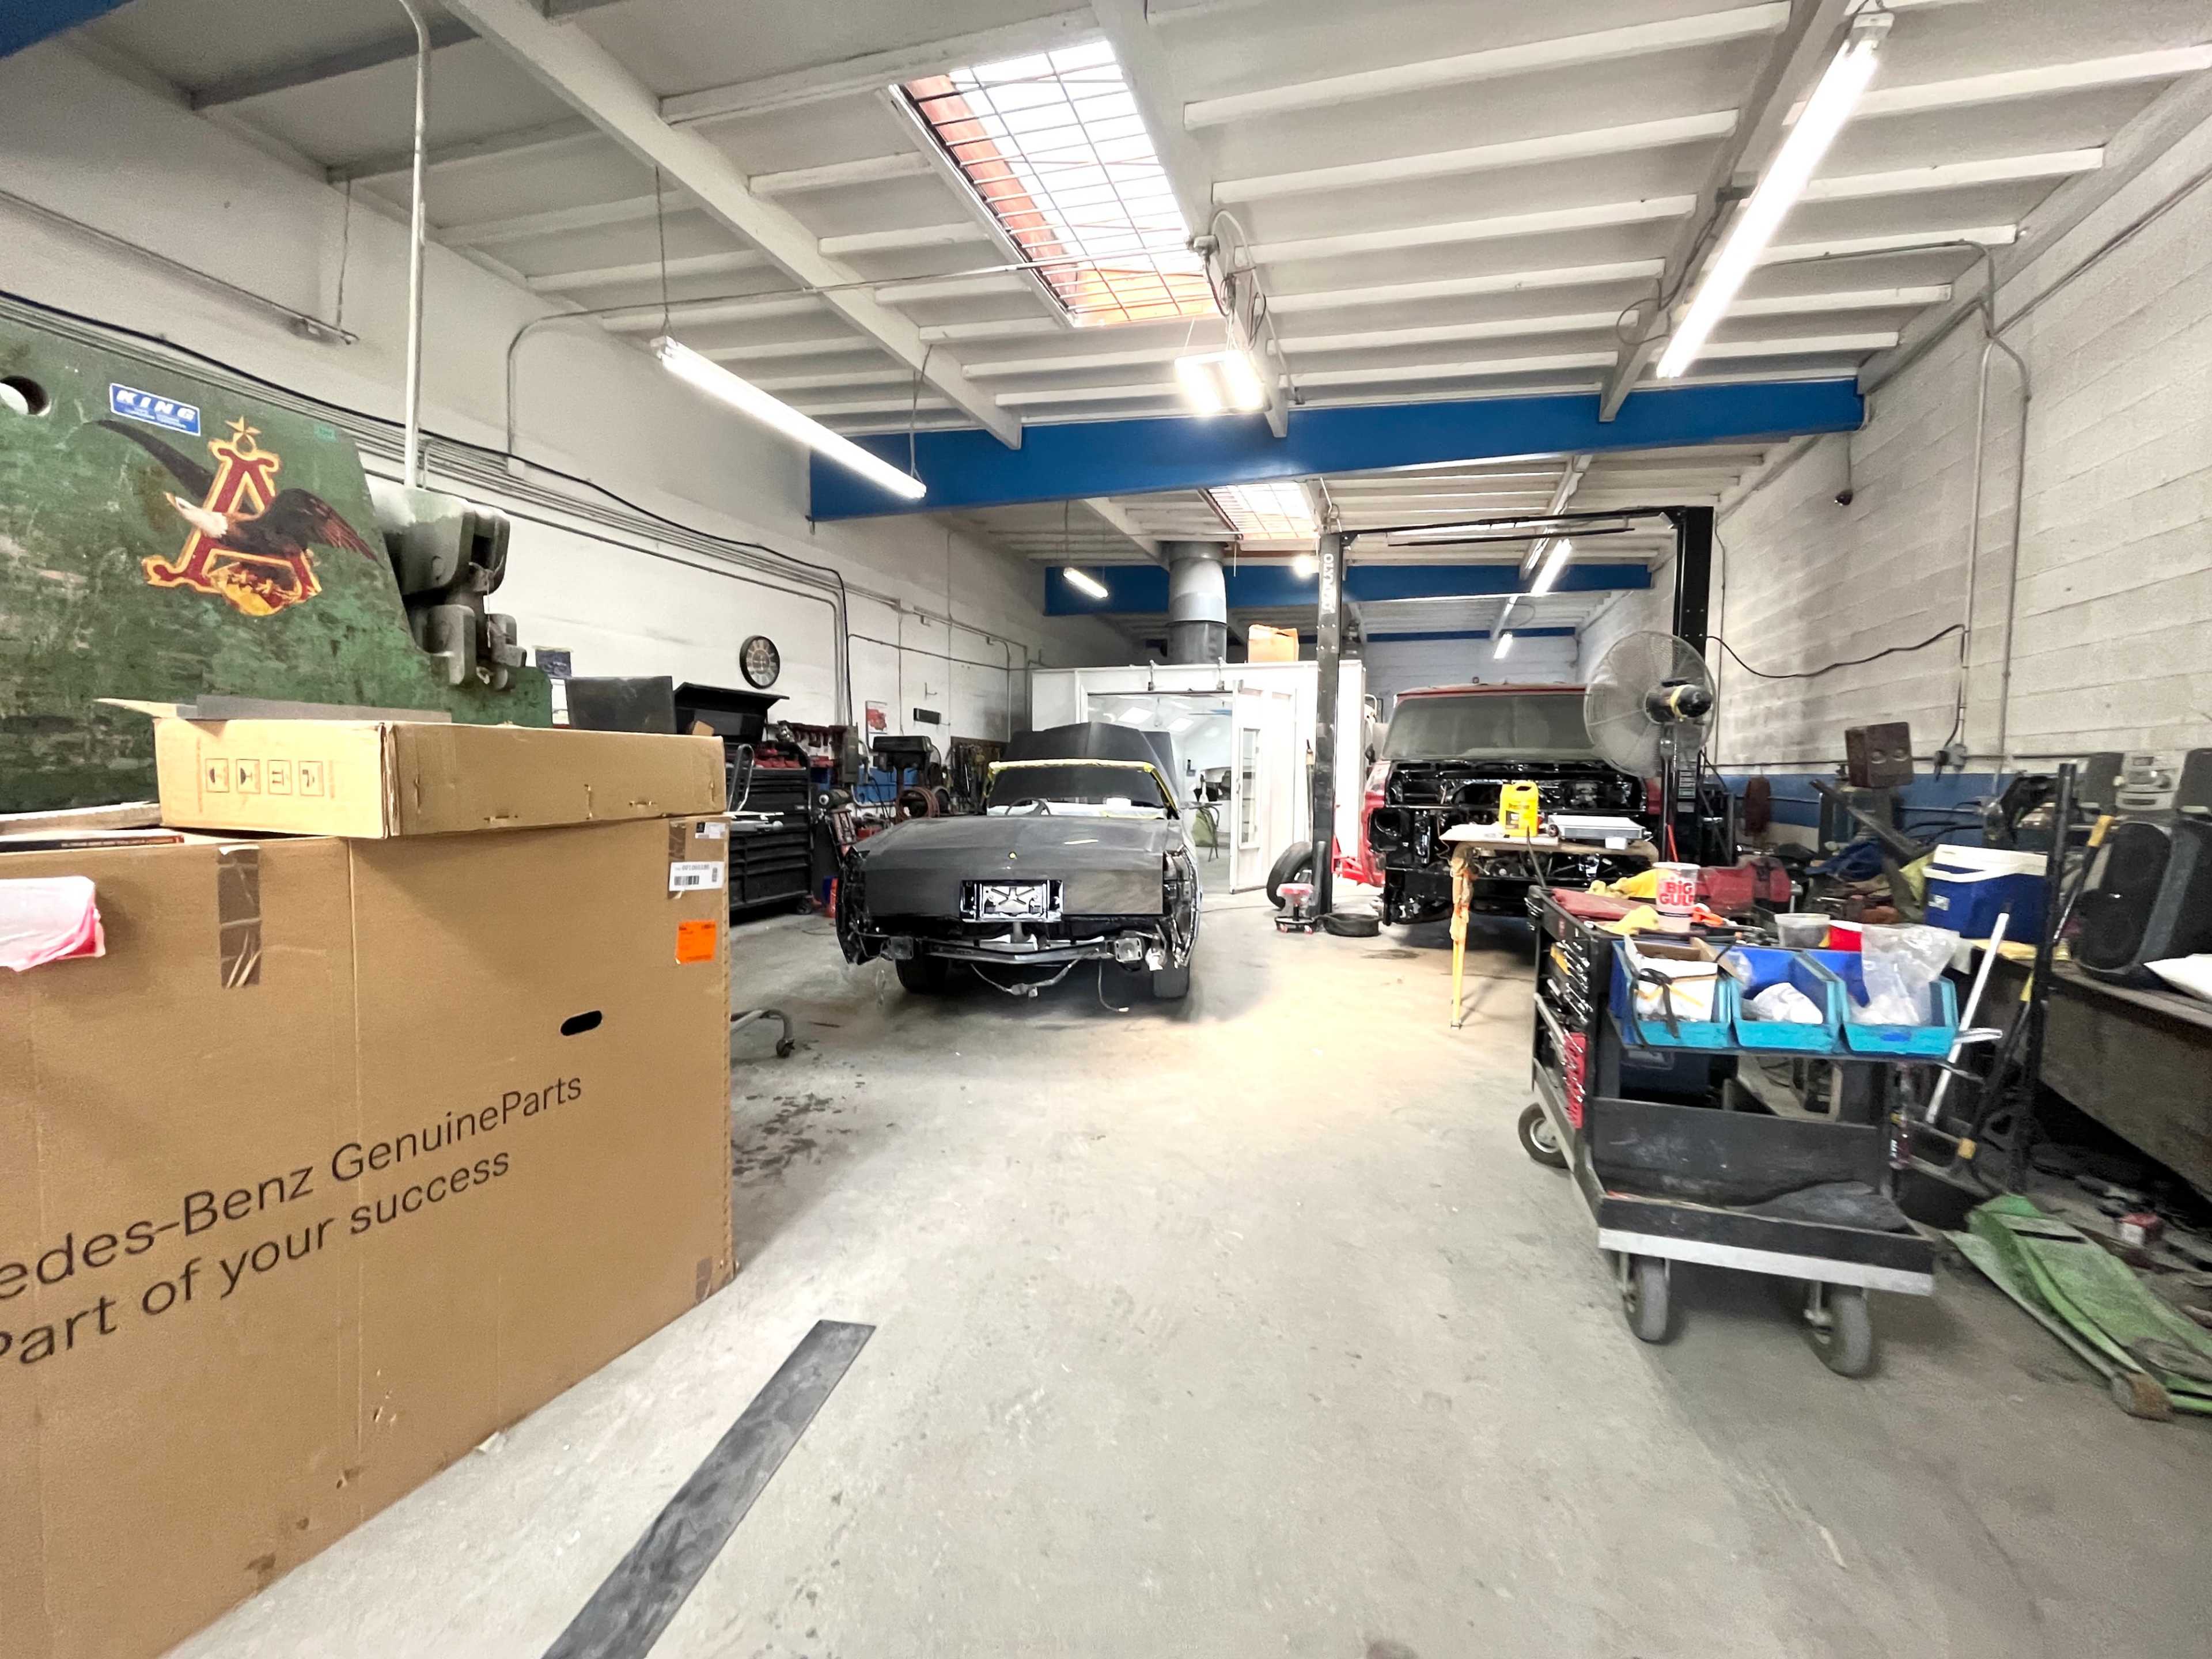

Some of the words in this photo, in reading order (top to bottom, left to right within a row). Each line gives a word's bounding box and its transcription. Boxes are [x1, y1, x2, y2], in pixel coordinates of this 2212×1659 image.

[116, 389, 196, 421] KING
[332, 1077, 581, 1181] GenuineParts
[142, 1257, 202, 1315] of
[219, 1217, 335, 1300] your
[350, 1152, 509, 1235] success
